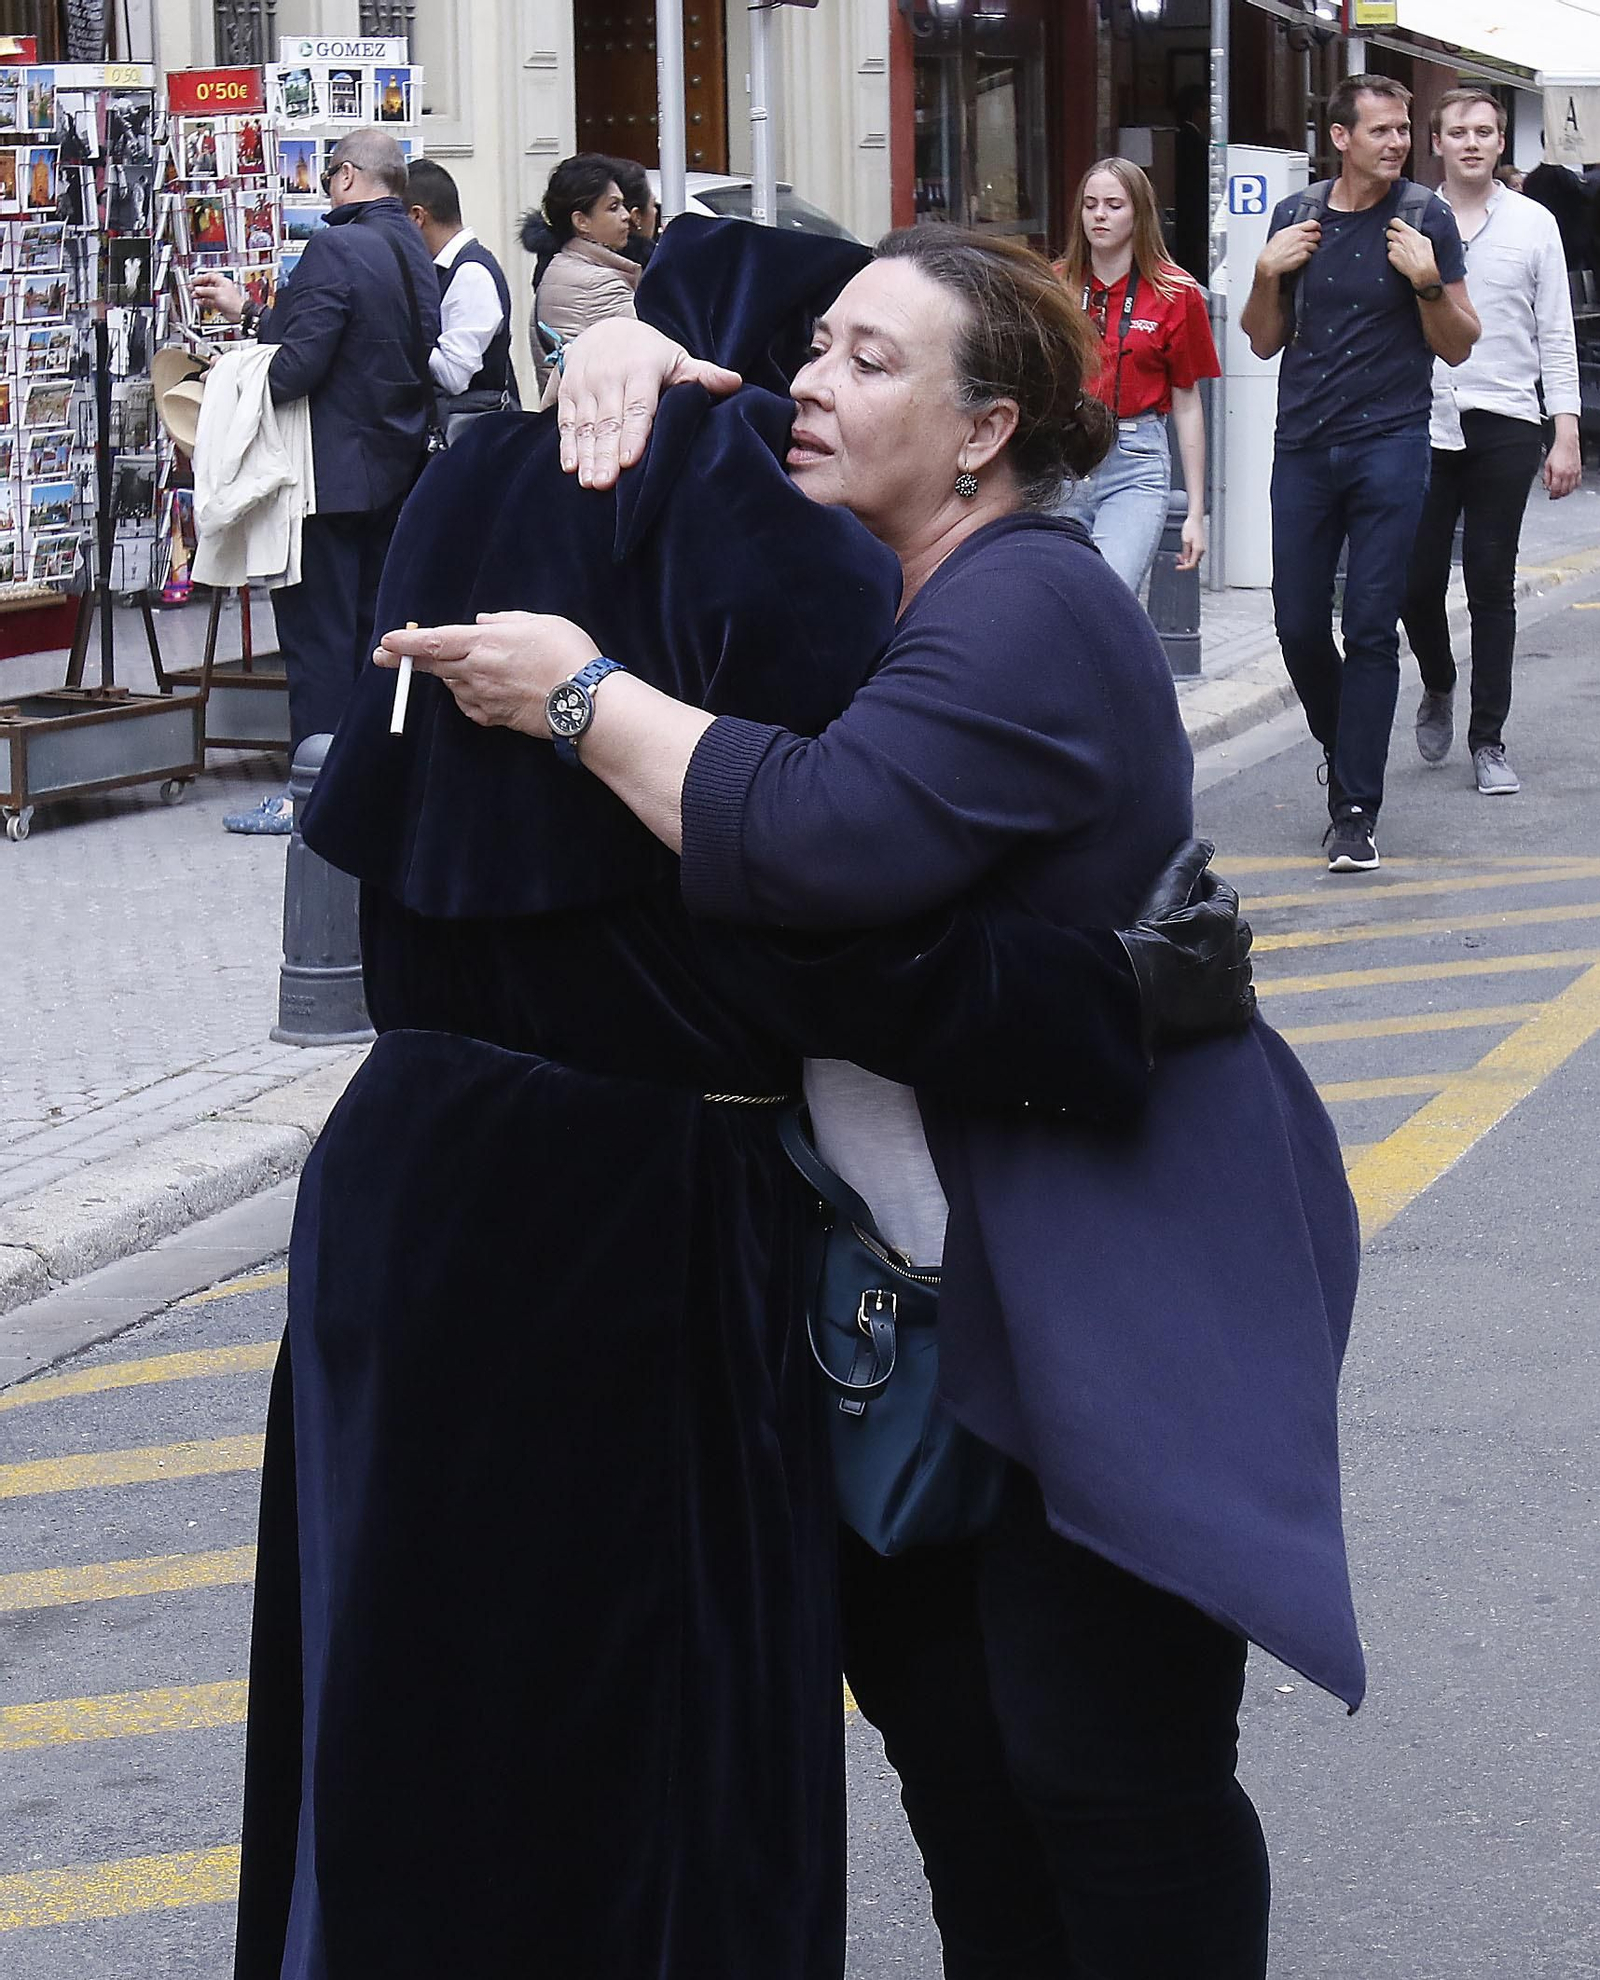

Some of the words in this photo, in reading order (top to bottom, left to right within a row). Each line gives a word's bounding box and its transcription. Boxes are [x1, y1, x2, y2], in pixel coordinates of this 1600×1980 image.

[316, 42, 386, 57] GOMEZ
[197, 82, 248, 100] 0'50€
[1564, 96, 1578, 131] A
